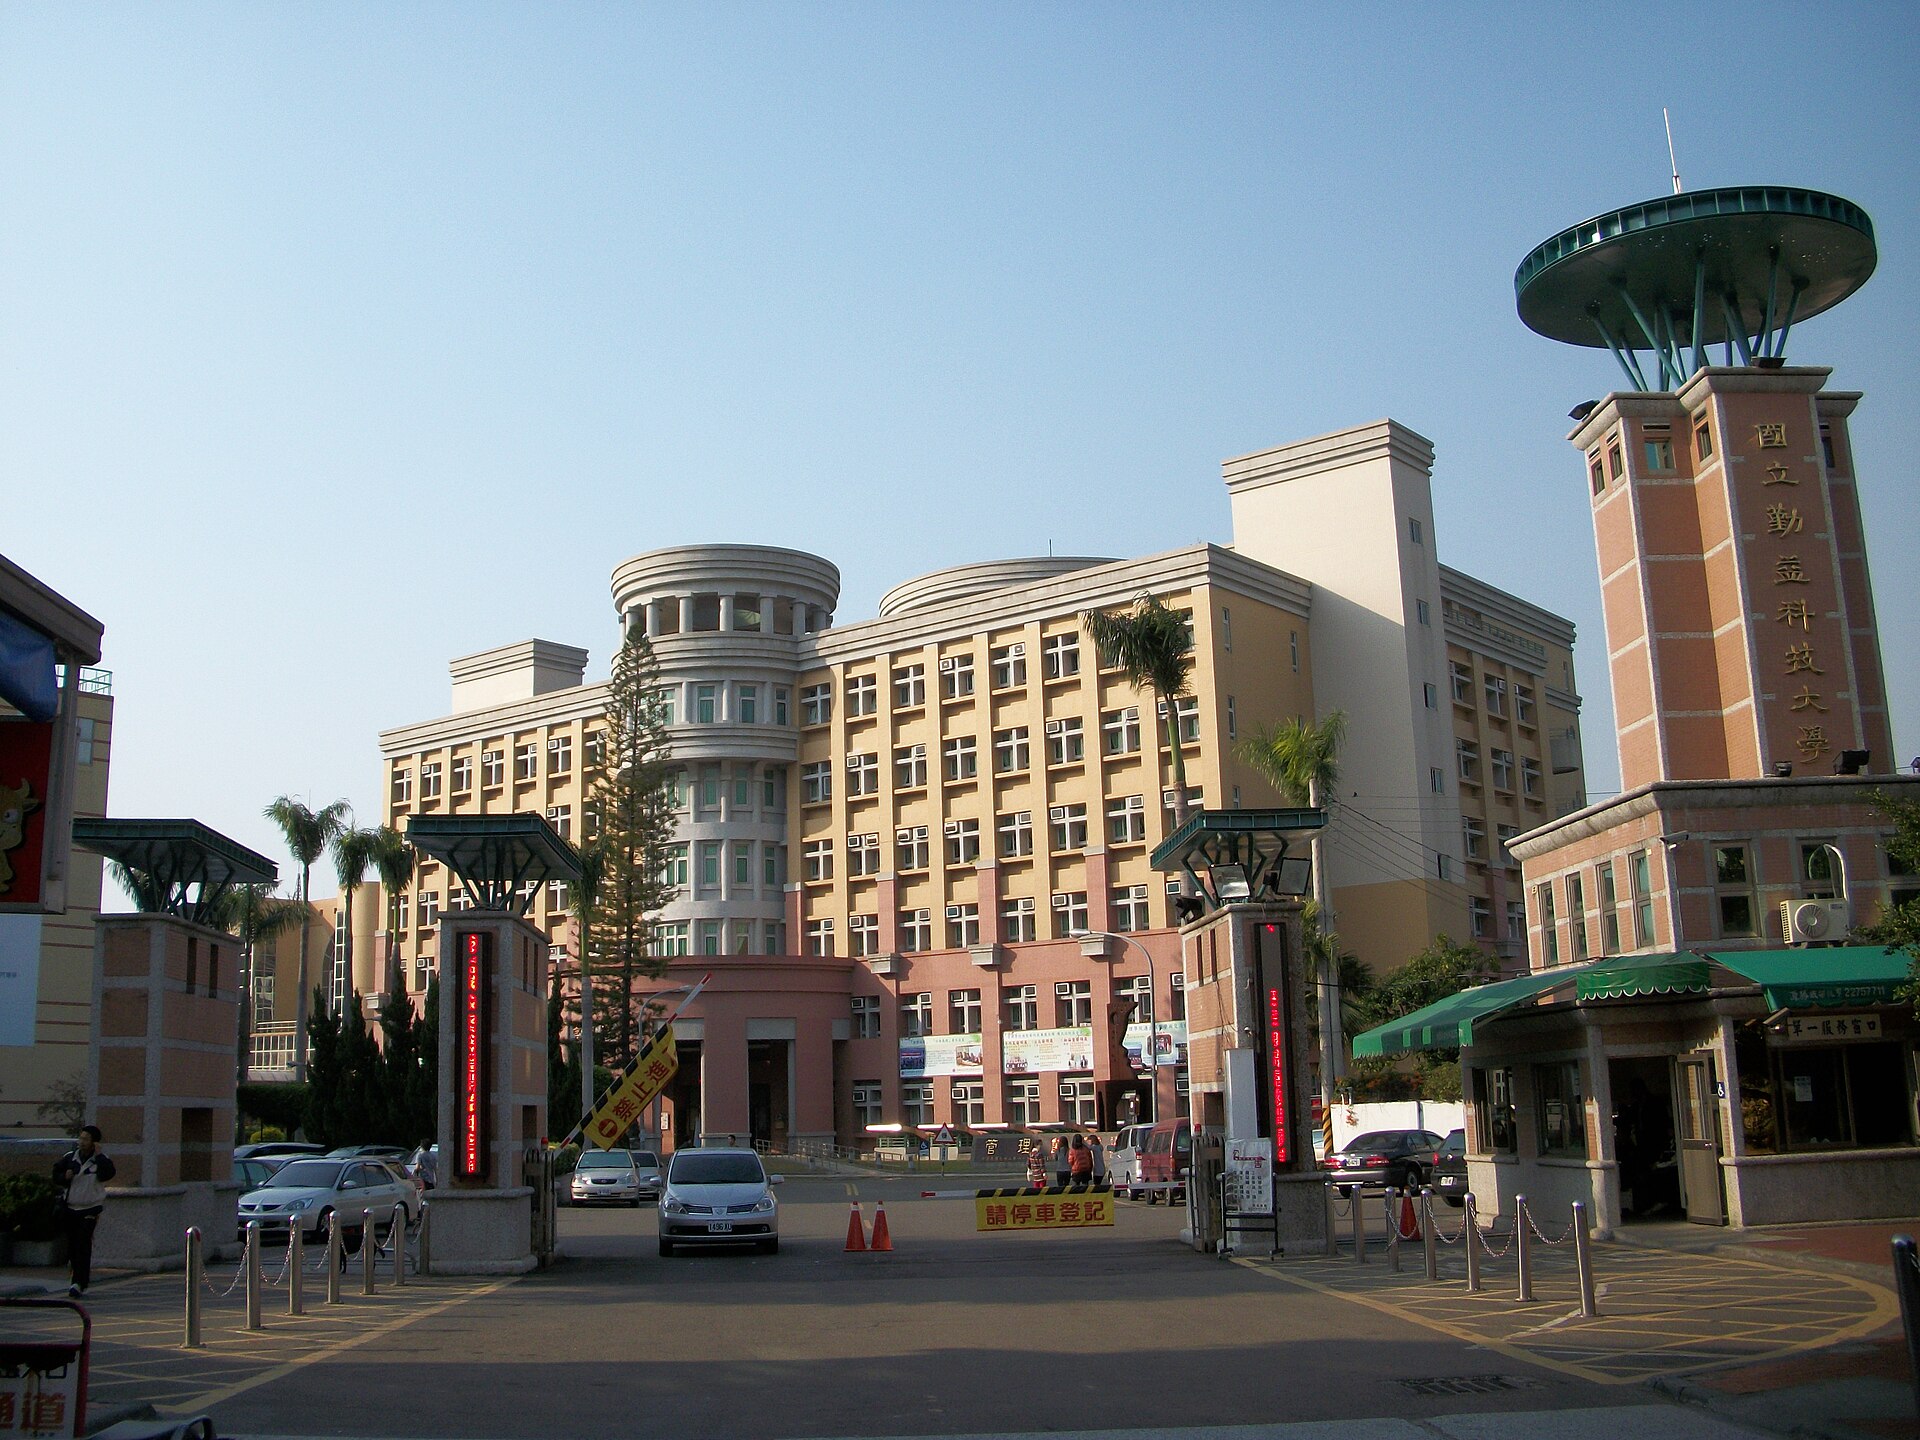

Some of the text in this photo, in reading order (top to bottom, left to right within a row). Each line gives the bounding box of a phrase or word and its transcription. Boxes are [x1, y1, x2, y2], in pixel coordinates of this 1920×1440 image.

[1754, 422, 1829, 764] 國立勤益科技大學
[985, 1200, 1105, 1225] 請停車登記
